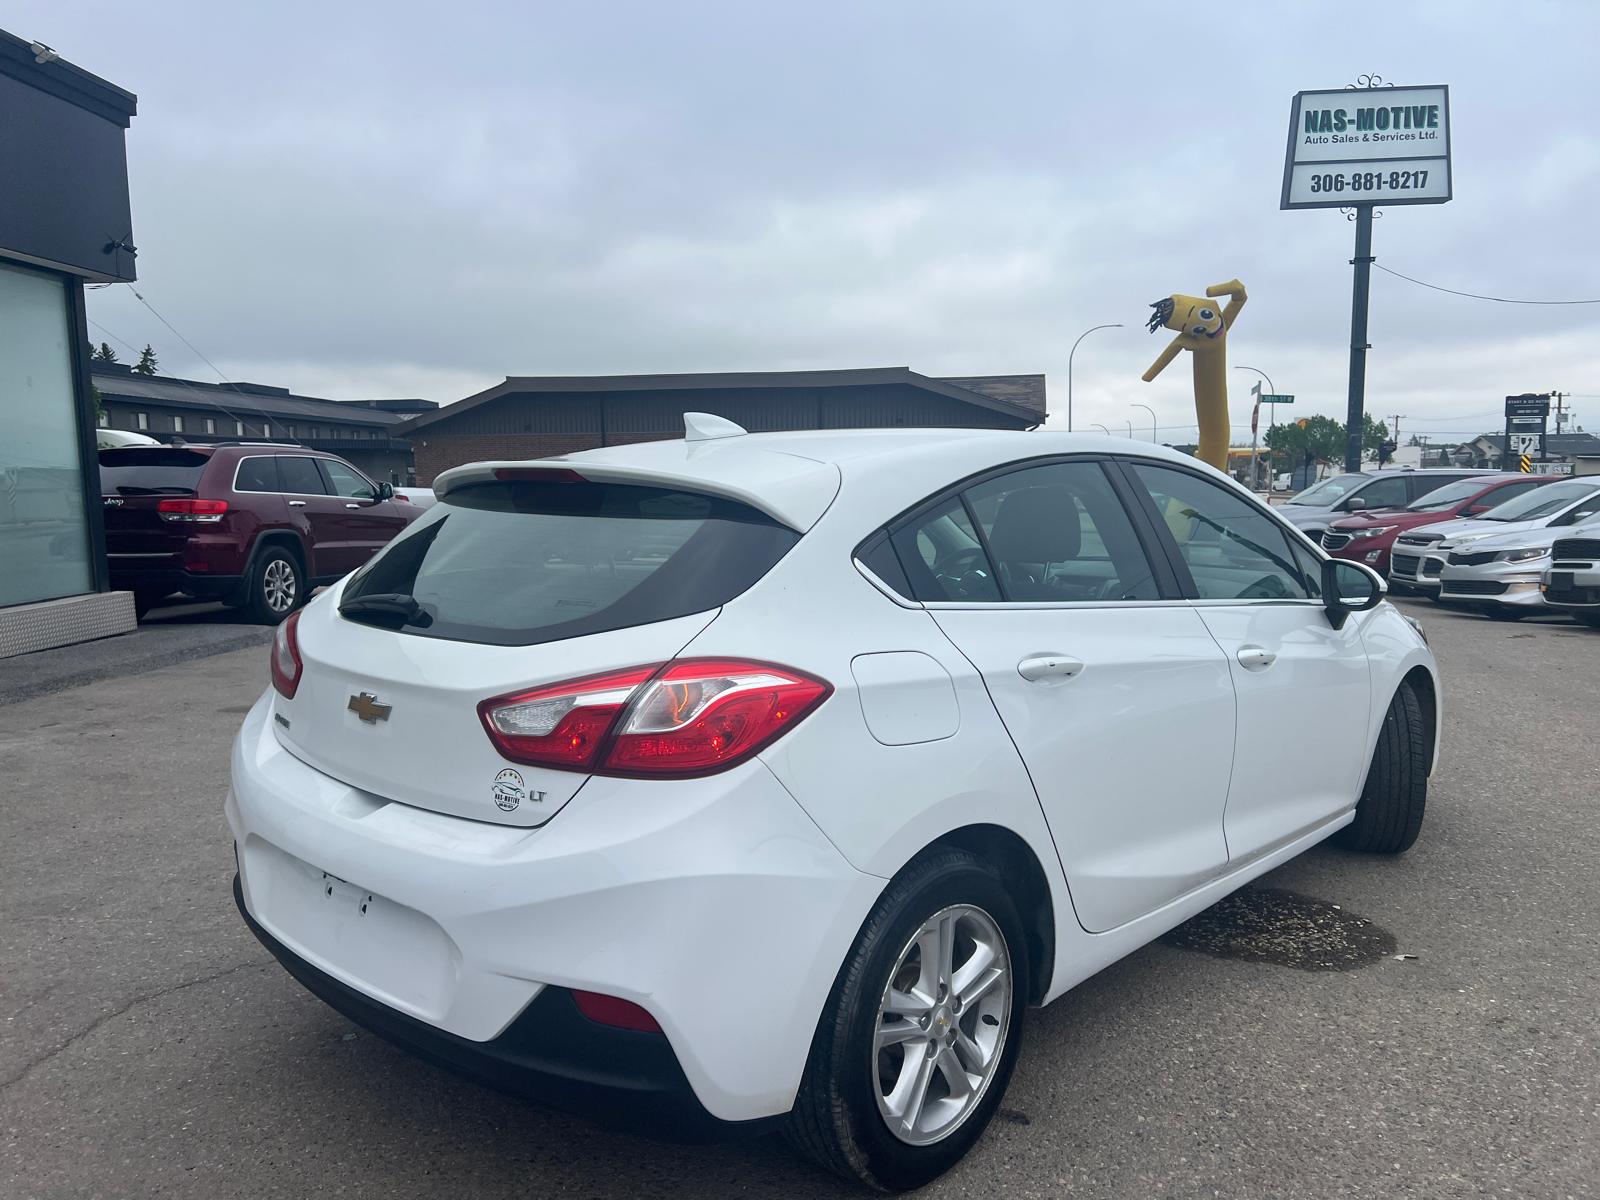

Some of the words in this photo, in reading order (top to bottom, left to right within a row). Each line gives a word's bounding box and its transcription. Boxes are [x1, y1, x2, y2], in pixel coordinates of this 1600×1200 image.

[1304, 104, 1440, 134] NAS-MOTIVE
[1304, 135, 1329, 145] Auto
[1331, 134, 1360, 143] Sales
[1362, 133, 1370, 142] &
[1372, 132, 1416, 142] Services
[1418, 131, 1438, 140] Ltd.
[1310, 170, 1429, 193] 306-881-8217
[104, 498, 124, 506] Jeep
[494, 793, 520, 804] NAS-MOTIVE
[529, 790, 547, 802] LT
